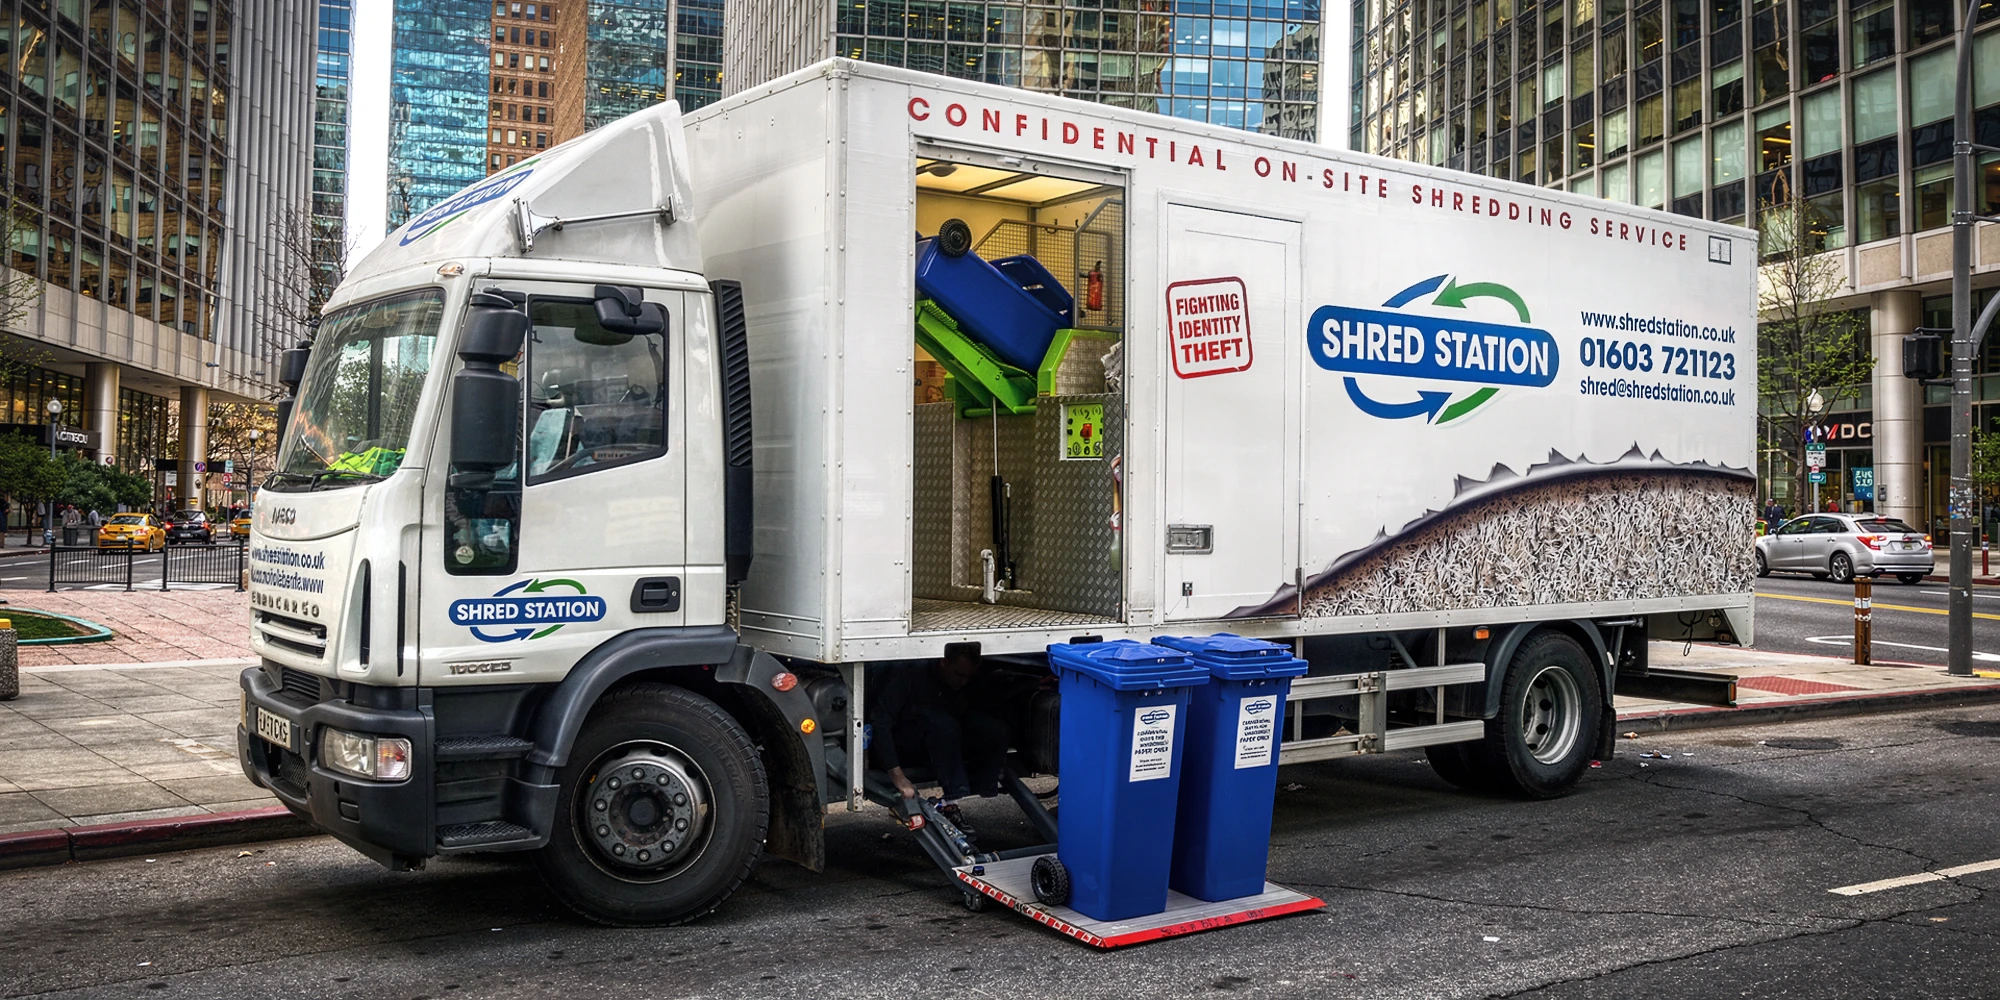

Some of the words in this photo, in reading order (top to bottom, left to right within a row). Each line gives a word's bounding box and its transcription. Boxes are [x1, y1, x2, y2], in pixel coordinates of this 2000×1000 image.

[908, 97, 1226, 170] CONFIDENTIAL
[1254, 156, 1387, 198] ON-SITE
[1412, 185, 1572, 229] SHREDDING
[1591, 217, 1687, 250] SERVICE
[1176, 293, 1240, 316] FIGHTING
[1179, 315, 1241, 340] IDENTITY
[1581, 311, 1736, 344] www.shredstation.co.uk
[1180, 337, 1243, 363] THEFT
[1322, 318, 1425, 364] SHRED
[1434, 329, 1549, 377] STATION
[1580, 337, 1654, 373] 01603
[1661, 346, 1736, 380] 721123
[1580, 376, 1735, 406] shred@shredstation.co.uk
[457, 604, 519, 620] SHRED
[524, 602, 600, 618] STATION
